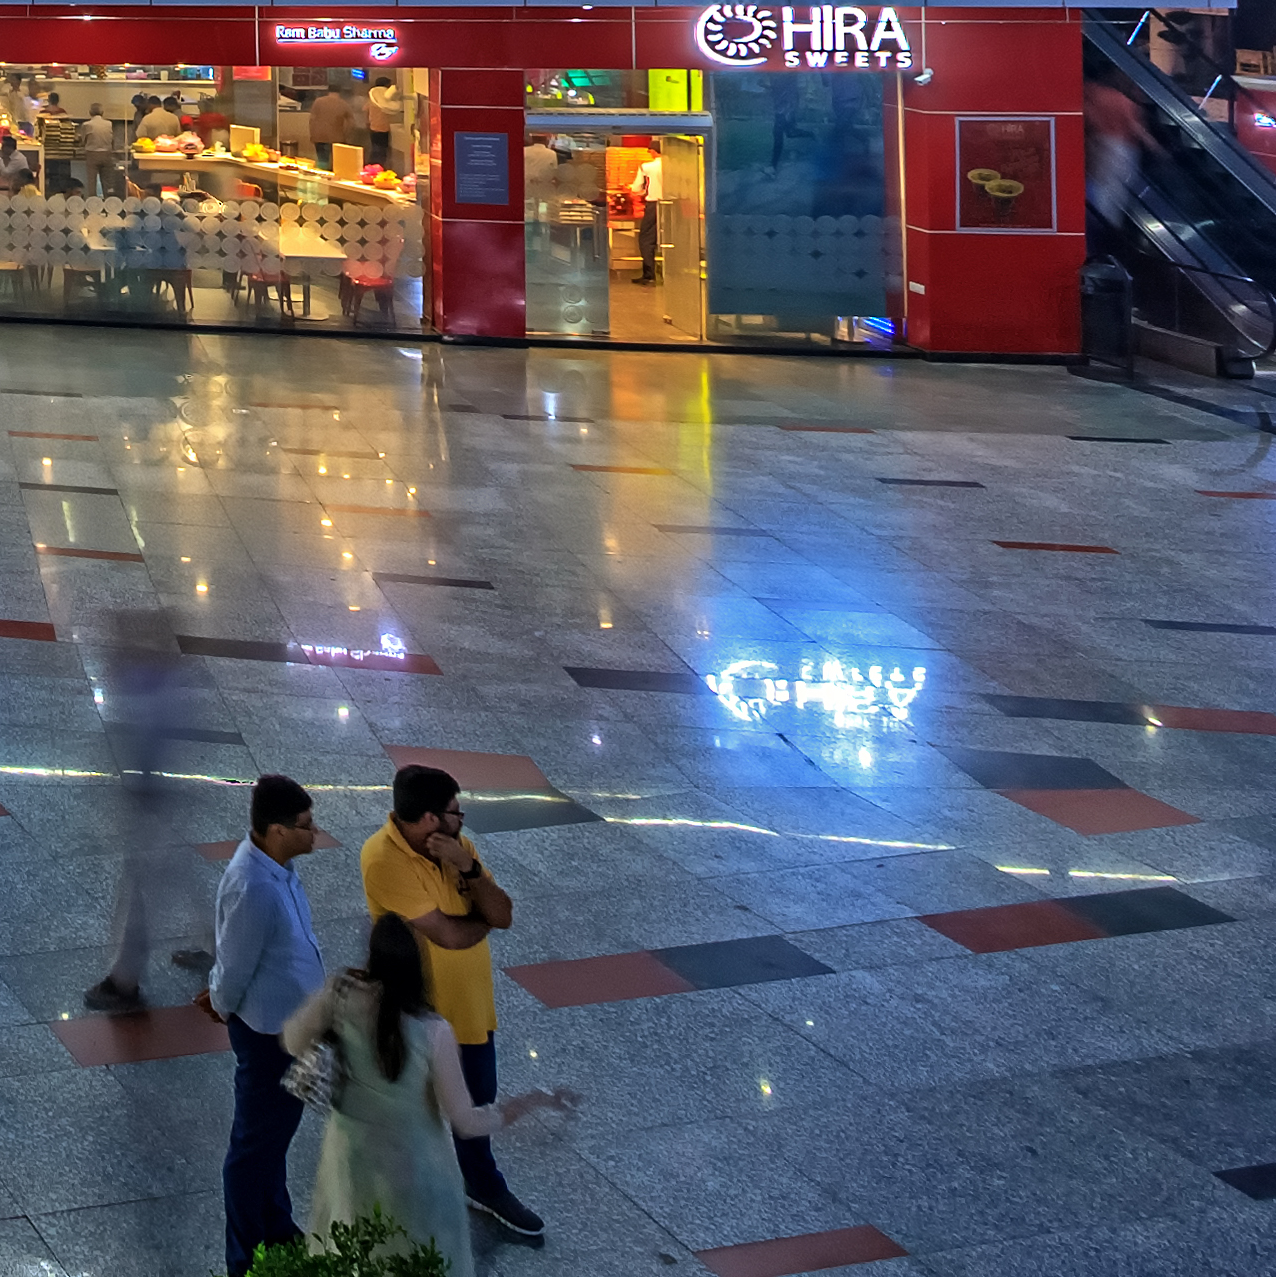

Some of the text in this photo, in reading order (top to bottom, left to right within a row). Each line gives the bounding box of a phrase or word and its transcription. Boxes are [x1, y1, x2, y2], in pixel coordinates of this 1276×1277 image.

[275, 25, 395, 40] Ram Babu Sharma
[781, 4, 911, 52] HIRA
[783, 50, 914, 69] SWEETS
